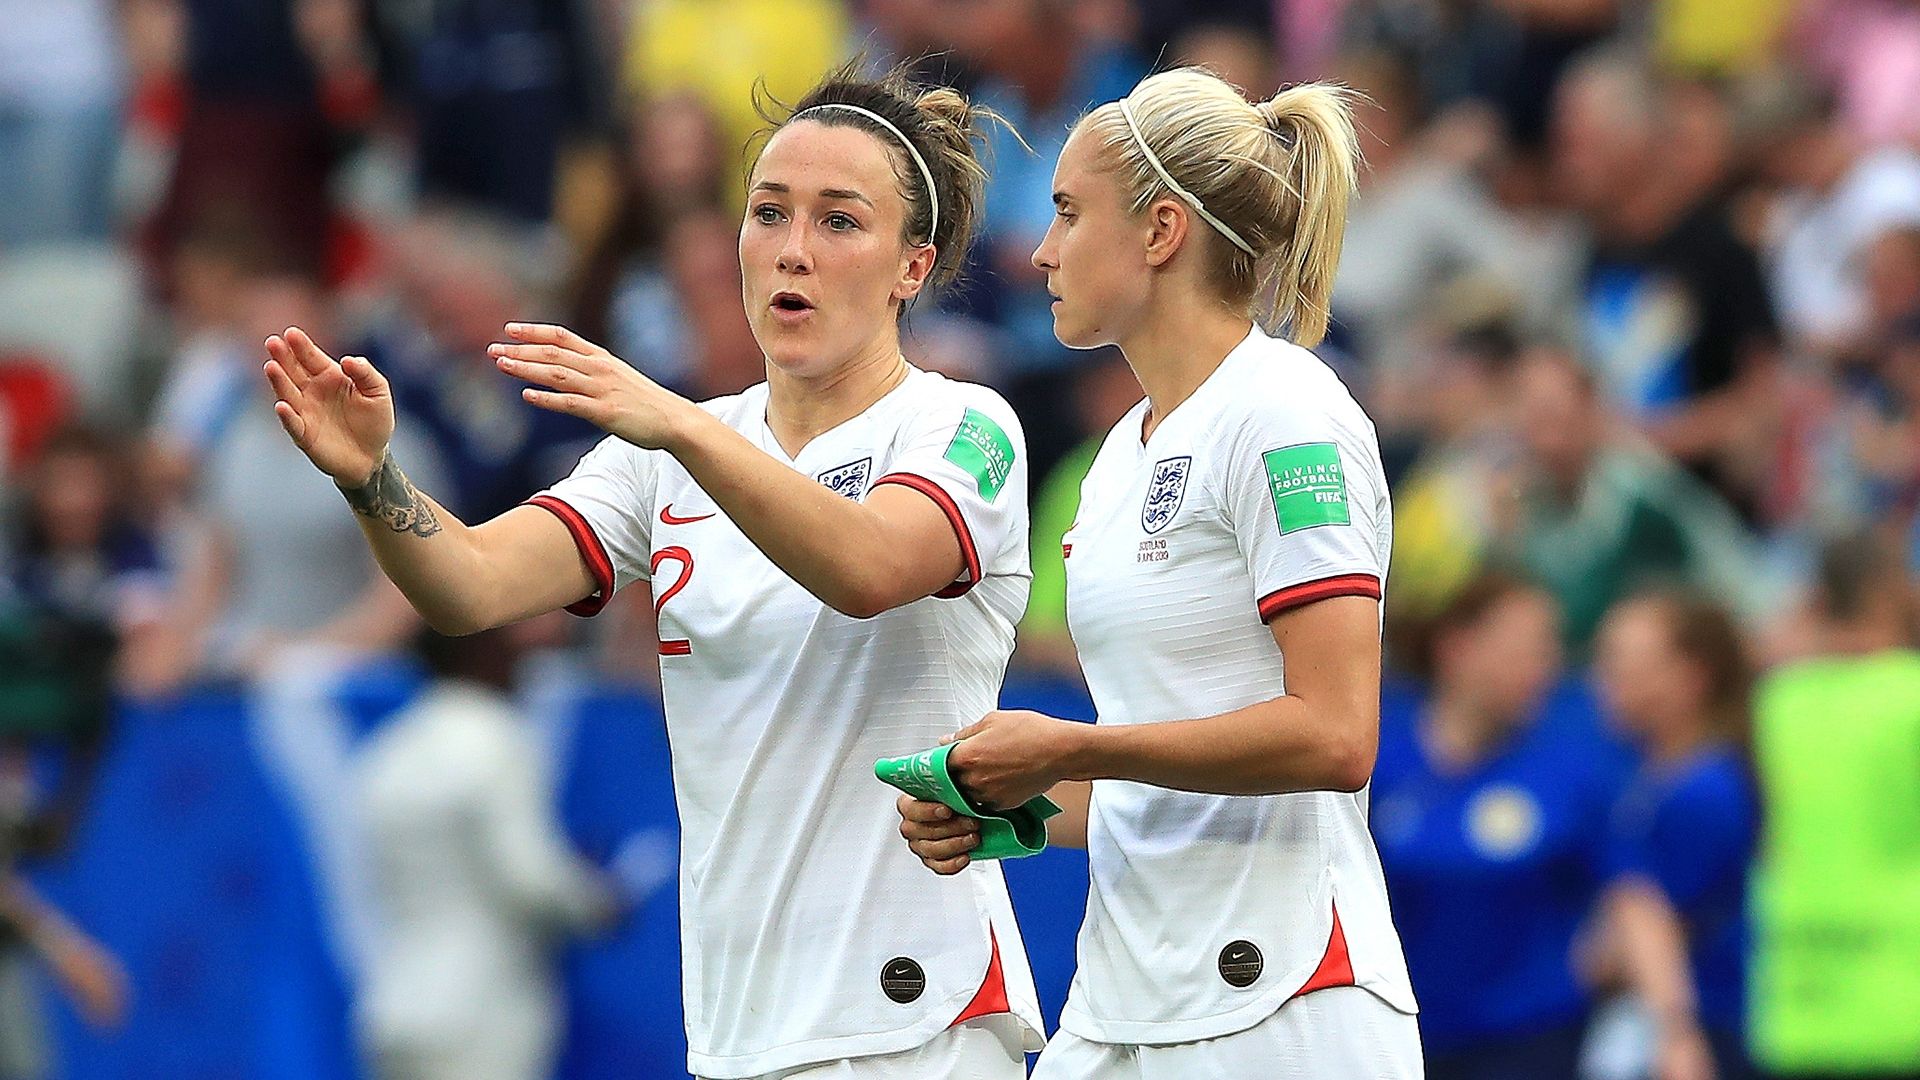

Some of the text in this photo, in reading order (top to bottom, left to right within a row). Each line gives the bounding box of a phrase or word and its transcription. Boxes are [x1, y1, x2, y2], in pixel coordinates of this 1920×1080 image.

[963, 427, 1006, 476] FOOTBALL
[985, 460, 1000, 489] FIFA
[1273, 463, 1338, 482] LIVING
[1275, 474, 1340, 492] FOOTBALL
[1314, 491, 1343, 503] FIFA
[1139, 539, 1167, 551] SCOTLAND
[650, 545, 694, 655] 2
